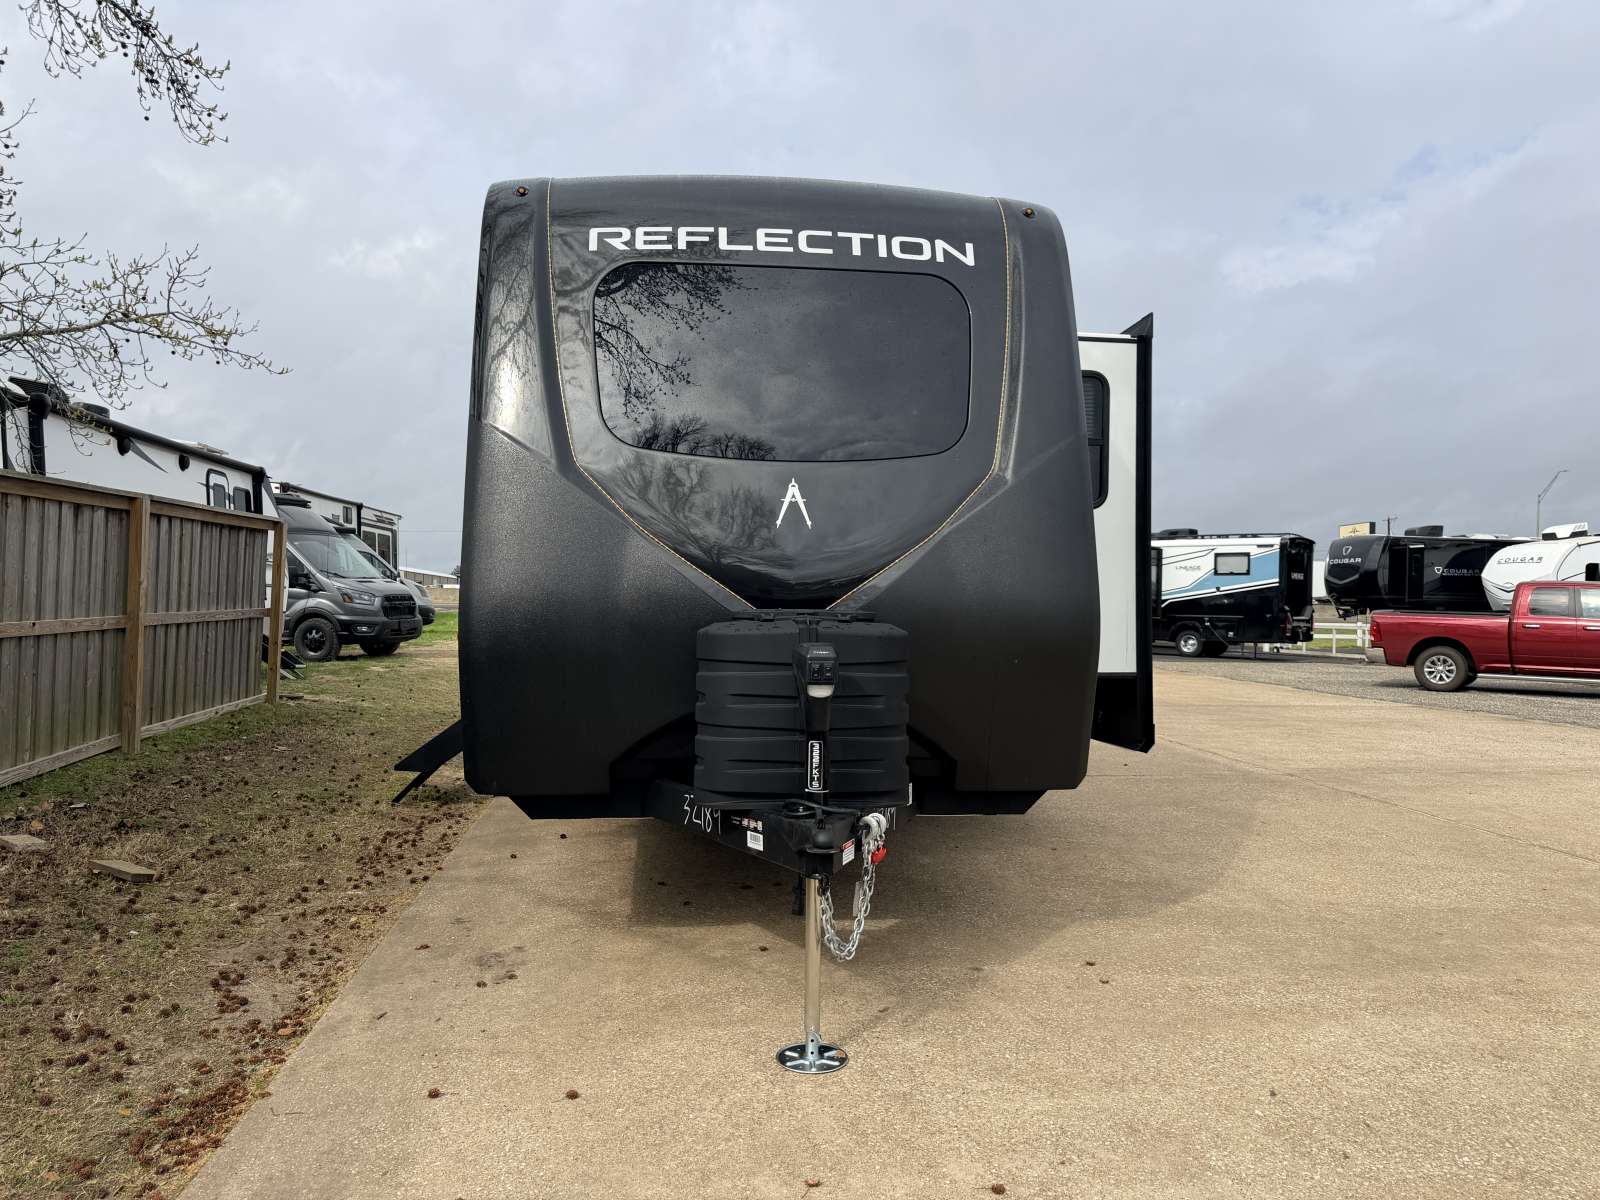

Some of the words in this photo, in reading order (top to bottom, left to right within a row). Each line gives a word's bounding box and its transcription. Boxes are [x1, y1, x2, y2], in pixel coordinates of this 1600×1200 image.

[588, 226, 976, 267] REFLECTION
[1329, 557, 1362, 565] COUGAR
[1497, 556, 1544, 564] COUGAR
